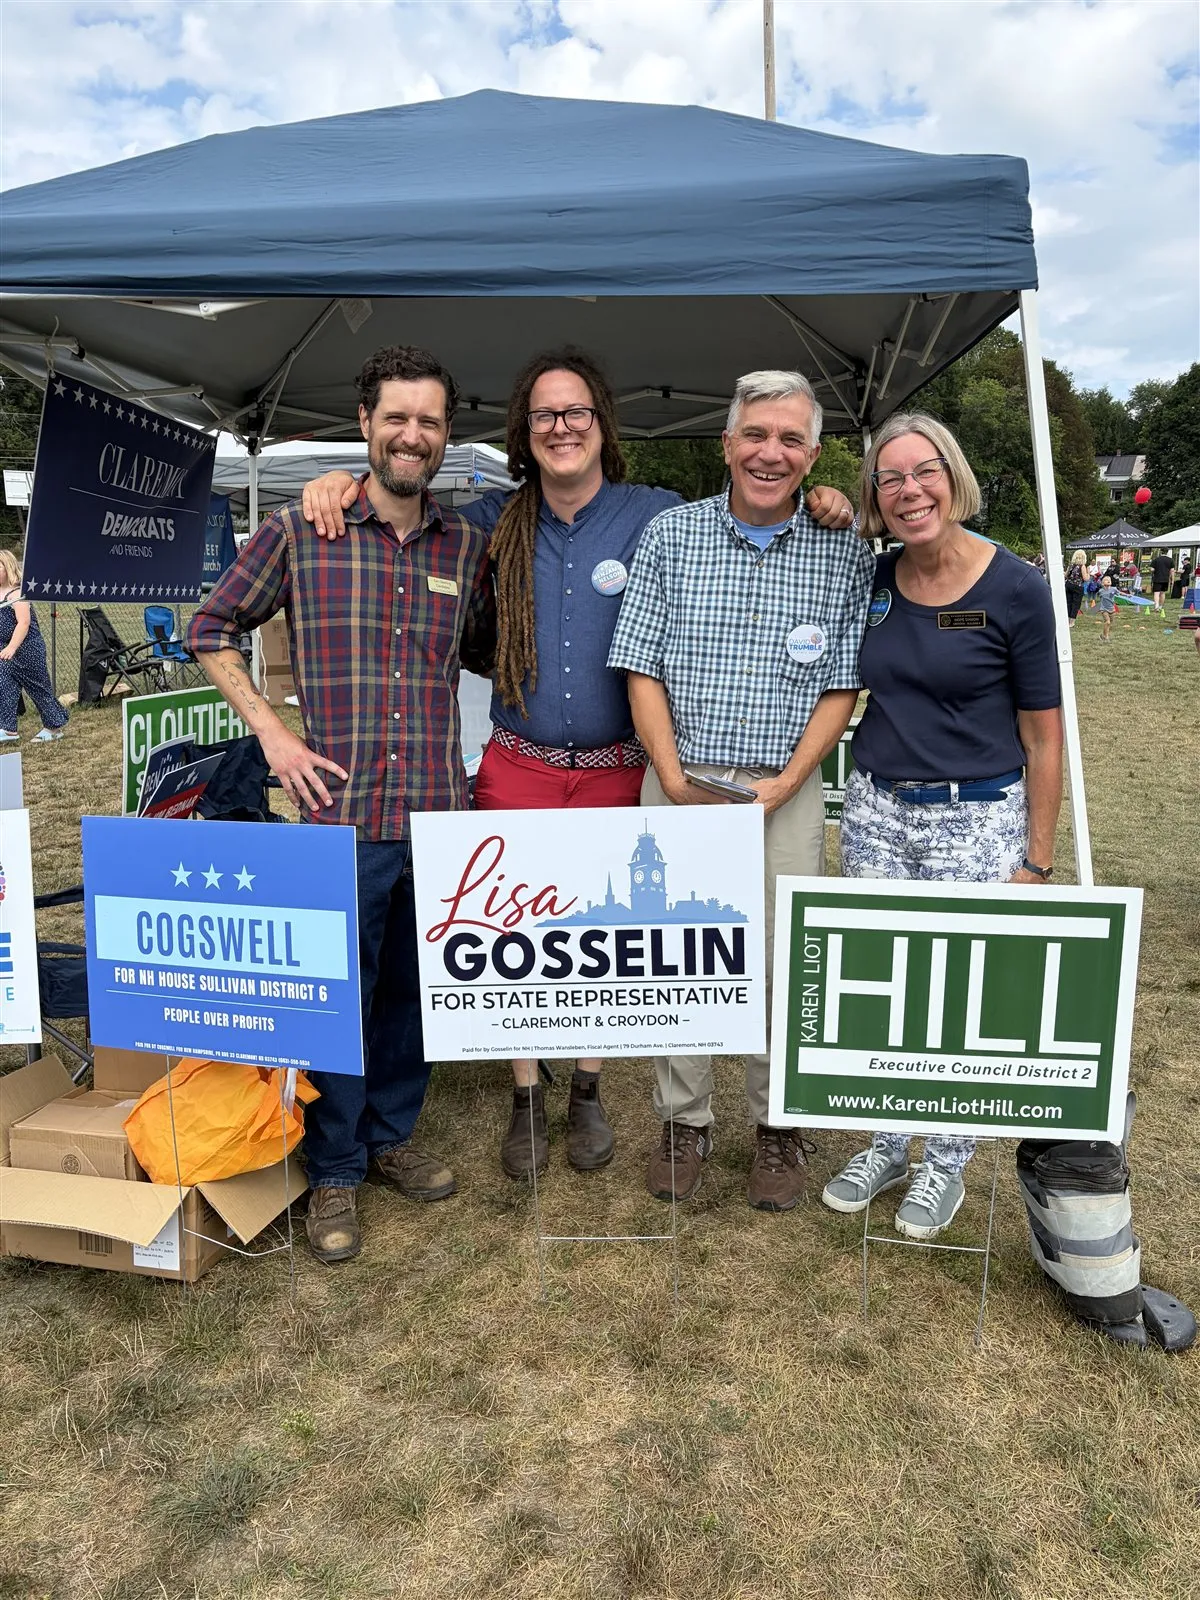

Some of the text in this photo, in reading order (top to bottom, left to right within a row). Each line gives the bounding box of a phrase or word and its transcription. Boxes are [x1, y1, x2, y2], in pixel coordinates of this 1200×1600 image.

[101, 511, 175, 541] DEMOCRATS
[125, 544, 152, 558] FRIENDS
[426, 835, 578, 943] Lisa
[136, 910, 301, 967] COGSWELL
[443, 927, 746, 982] GOSSELIN
[114, 966, 328, 1002] FOR NH HOUSE SULLIVAN DISTRICT 6
[431, 987, 748, 1011] FOR STATE REPRESENTATIVE
[800, 932, 822, 1044] KAREN LIOT
[823, 933, 1101, 1056] HILL
[164, 1008, 275, 1032] PEOPLE OVER PROFITS
[502, 1014, 679, 1030] CLAREMONT & CROYDON
[868, 1057, 1092, 1080] Executive Council District 2
[828, 1094, 1062, 1118] www.KarenLiotHill.com
